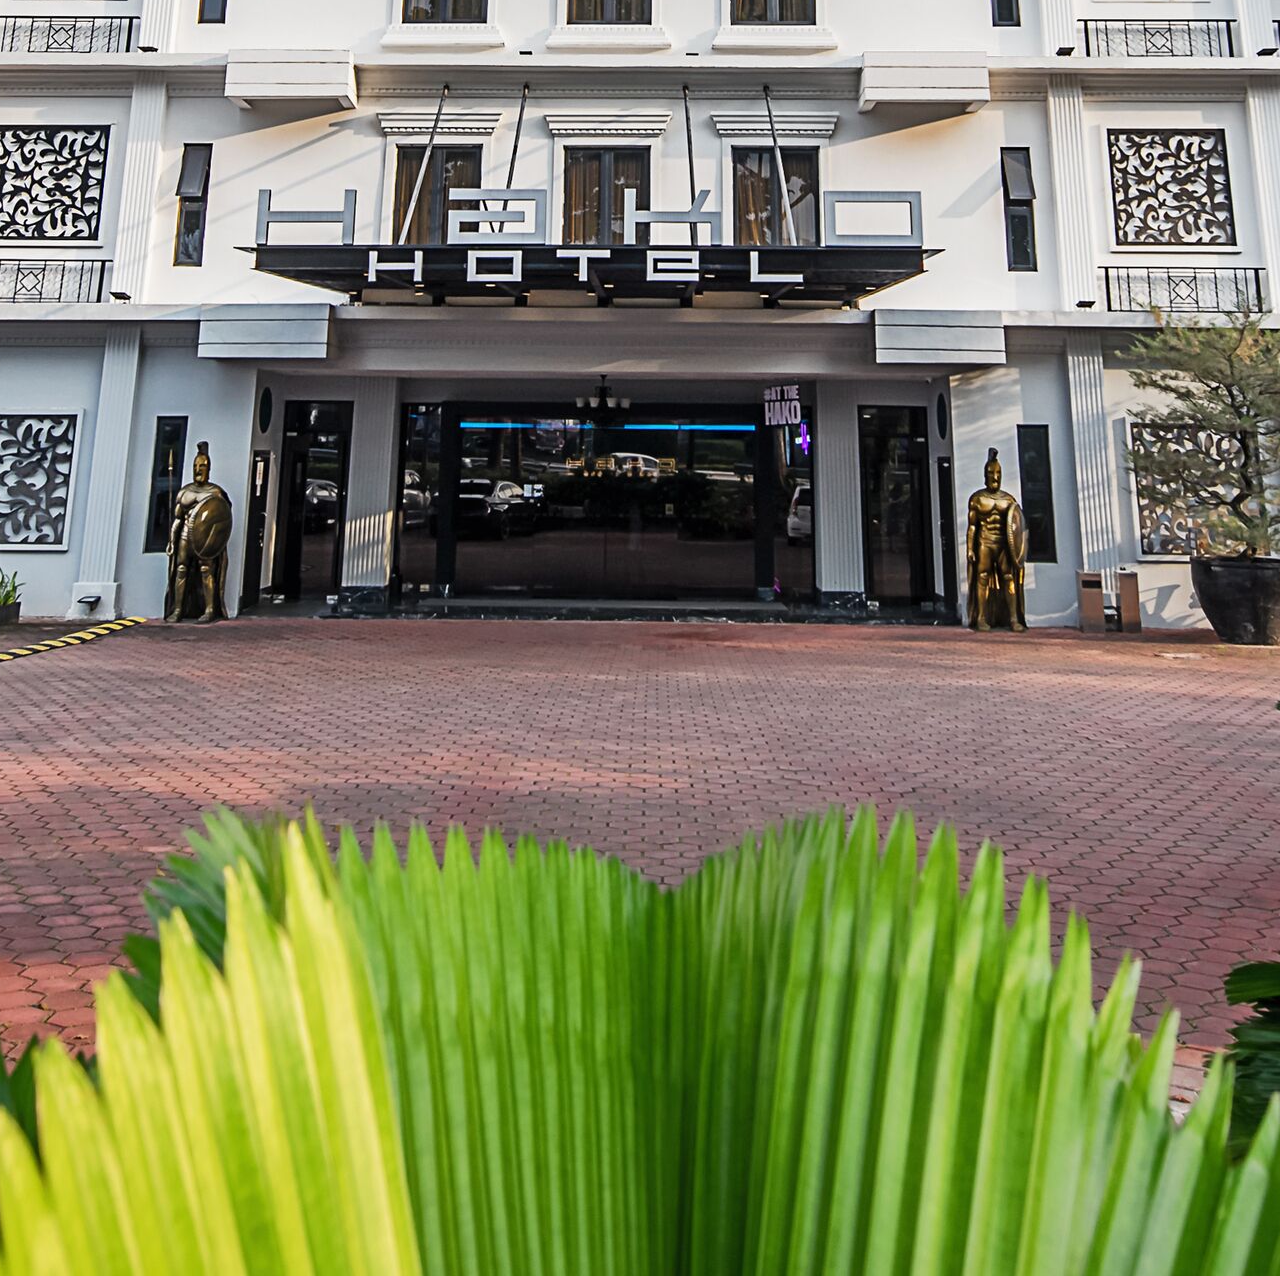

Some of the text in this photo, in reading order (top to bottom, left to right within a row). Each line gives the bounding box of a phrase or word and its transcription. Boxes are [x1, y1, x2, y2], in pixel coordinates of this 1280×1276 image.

[368, 249, 804, 284] HOTEL
[763, 385, 799, 401] #AT THE
[764, 400, 801, 426] HAKO
